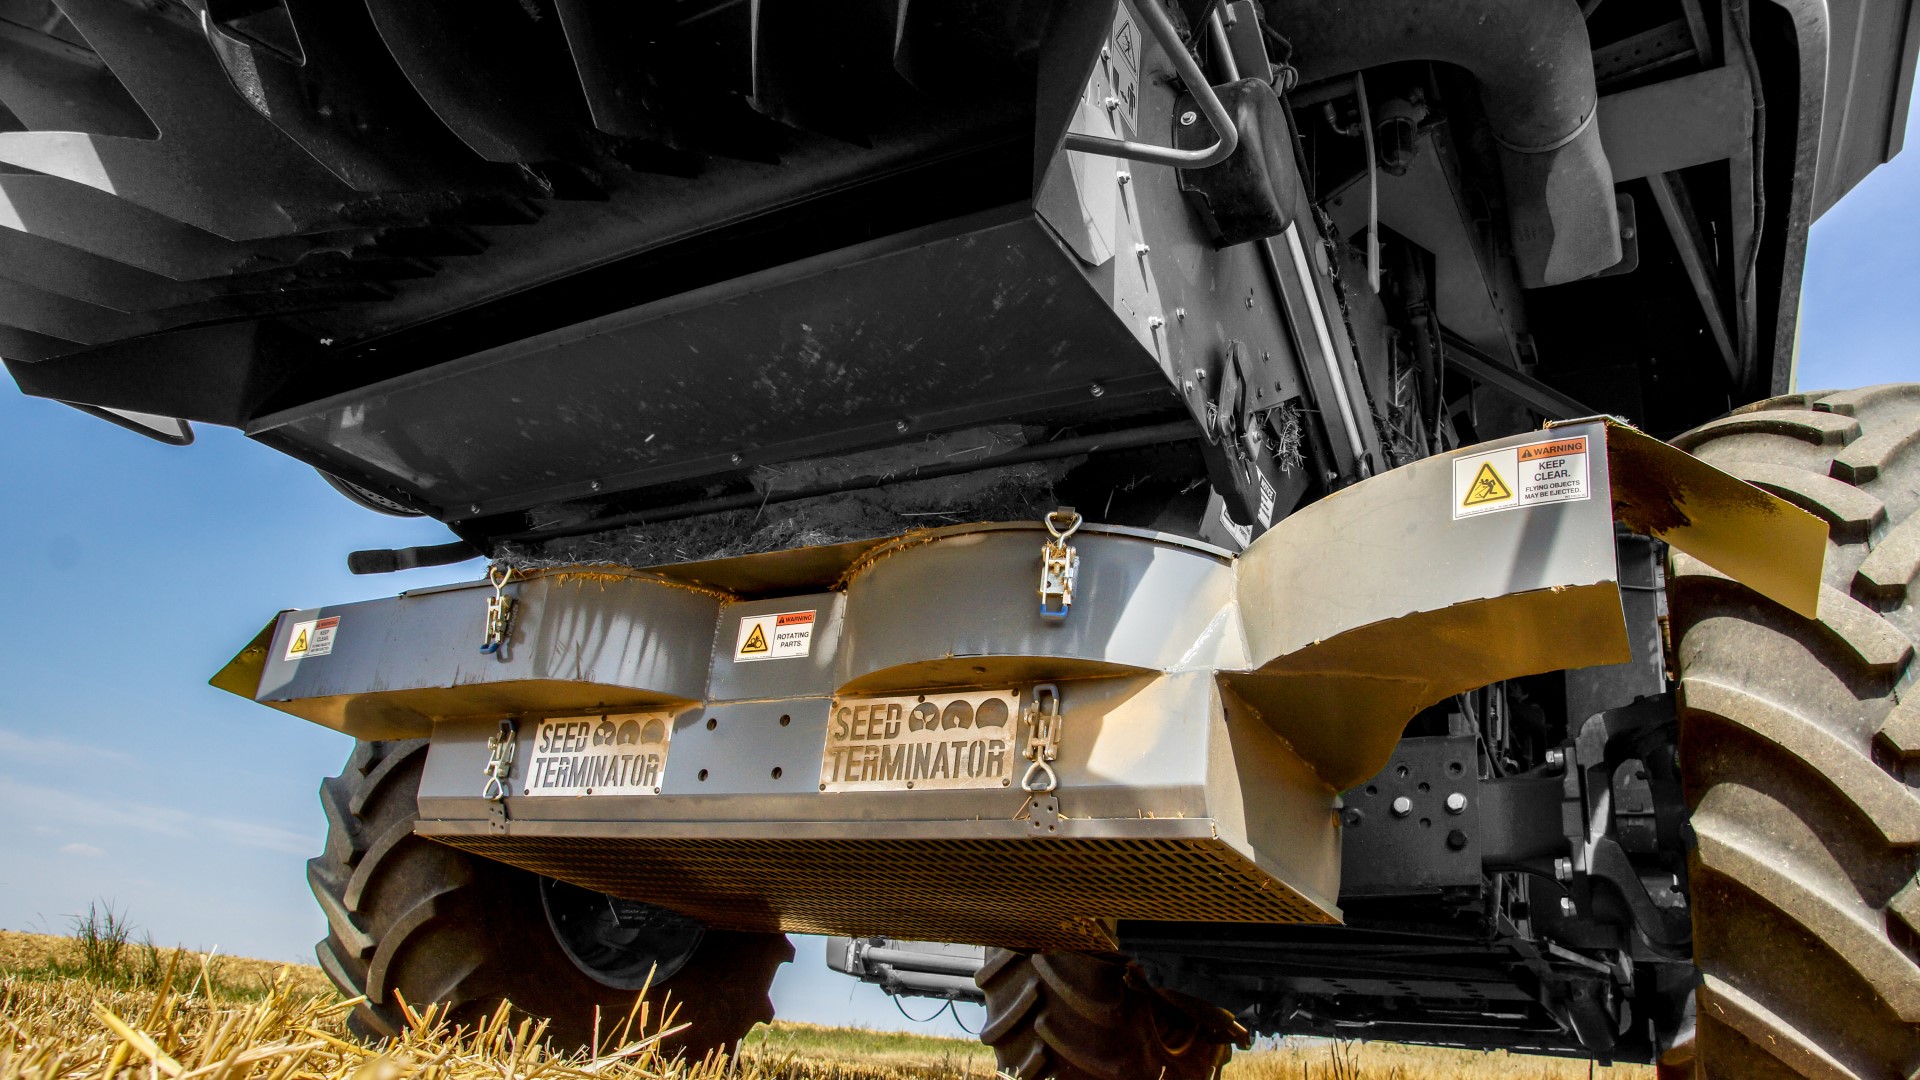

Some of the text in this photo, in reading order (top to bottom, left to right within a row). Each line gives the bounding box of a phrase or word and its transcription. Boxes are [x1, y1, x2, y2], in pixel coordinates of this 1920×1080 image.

[1534, 442, 1583, 456] WARNING
[1539, 459, 1565, 470] KEEP
[1534, 470, 1571, 482] CLEAR.
[1525, 480, 1580, 493] FLYING OBJECTS
[1550, 488, 1581, 496] EJECTED.
[777, 631, 809, 640] ROTATING
[780, 640, 803, 648] PARTS.
[835, 704, 903, 741] SEED
[539, 721, 590, 753] SEED
[833, 740, 1006, 782] TERMINATOR
[534, 754, 660, 788] TERMINATOR
